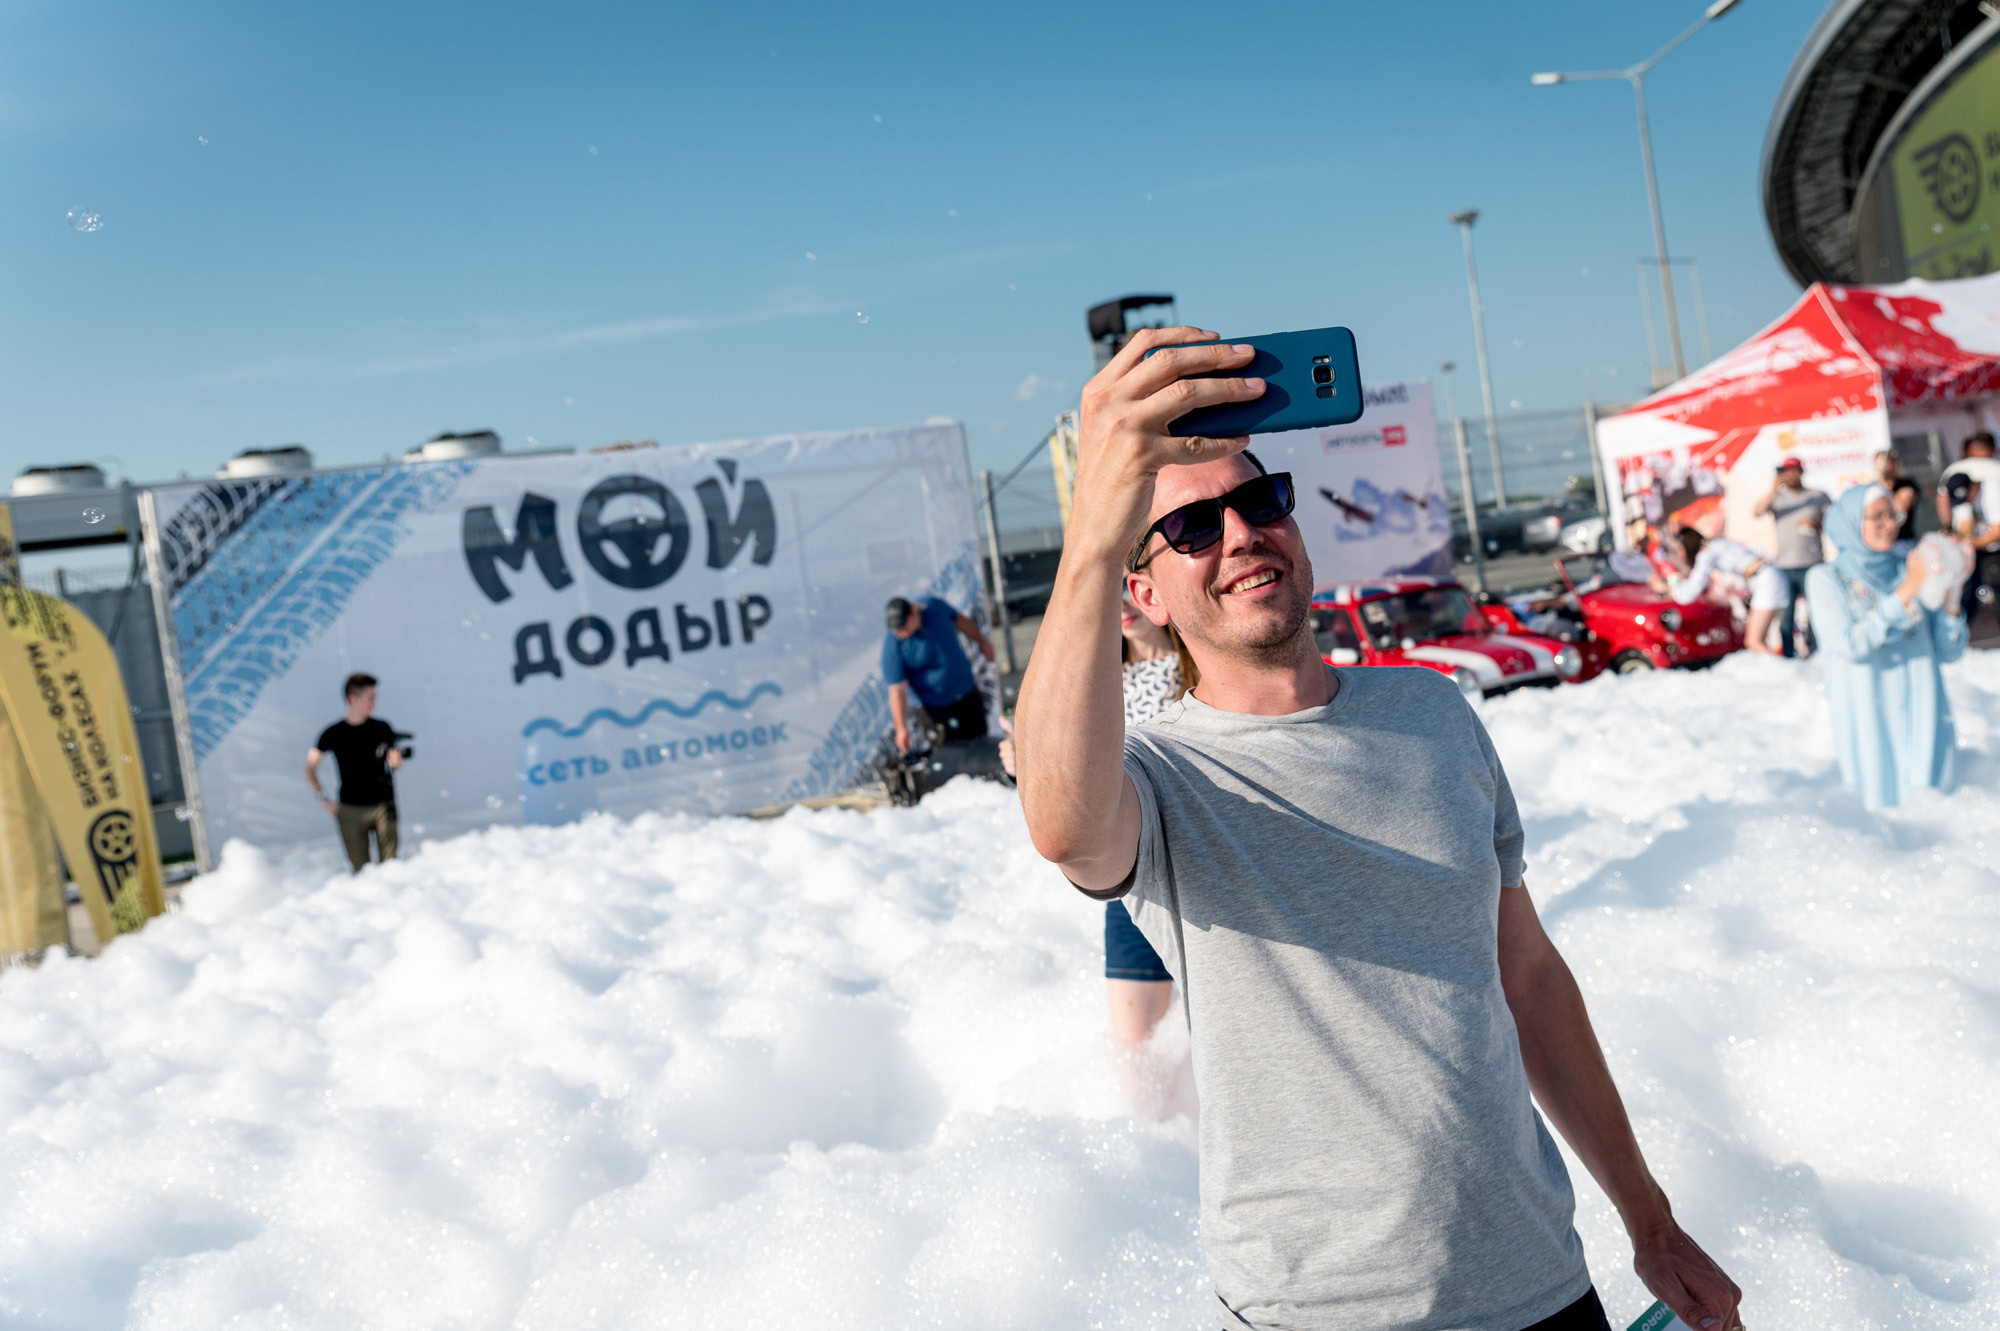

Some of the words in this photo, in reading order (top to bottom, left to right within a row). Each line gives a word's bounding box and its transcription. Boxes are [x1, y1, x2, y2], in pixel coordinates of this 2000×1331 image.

[463, 458, 776, 604] МОЙ
[512, 594, 772, 685] ДОДЫР
[26, 641, 98, 808] БИЗНЕС-ФОРУМ
[62, 669, 113, 768] КОЛЕСАХ
[529, 755, 610, 786] сеть
[621, 721, 790, 771] автомоек
[100, 766, 120, 800] НА
